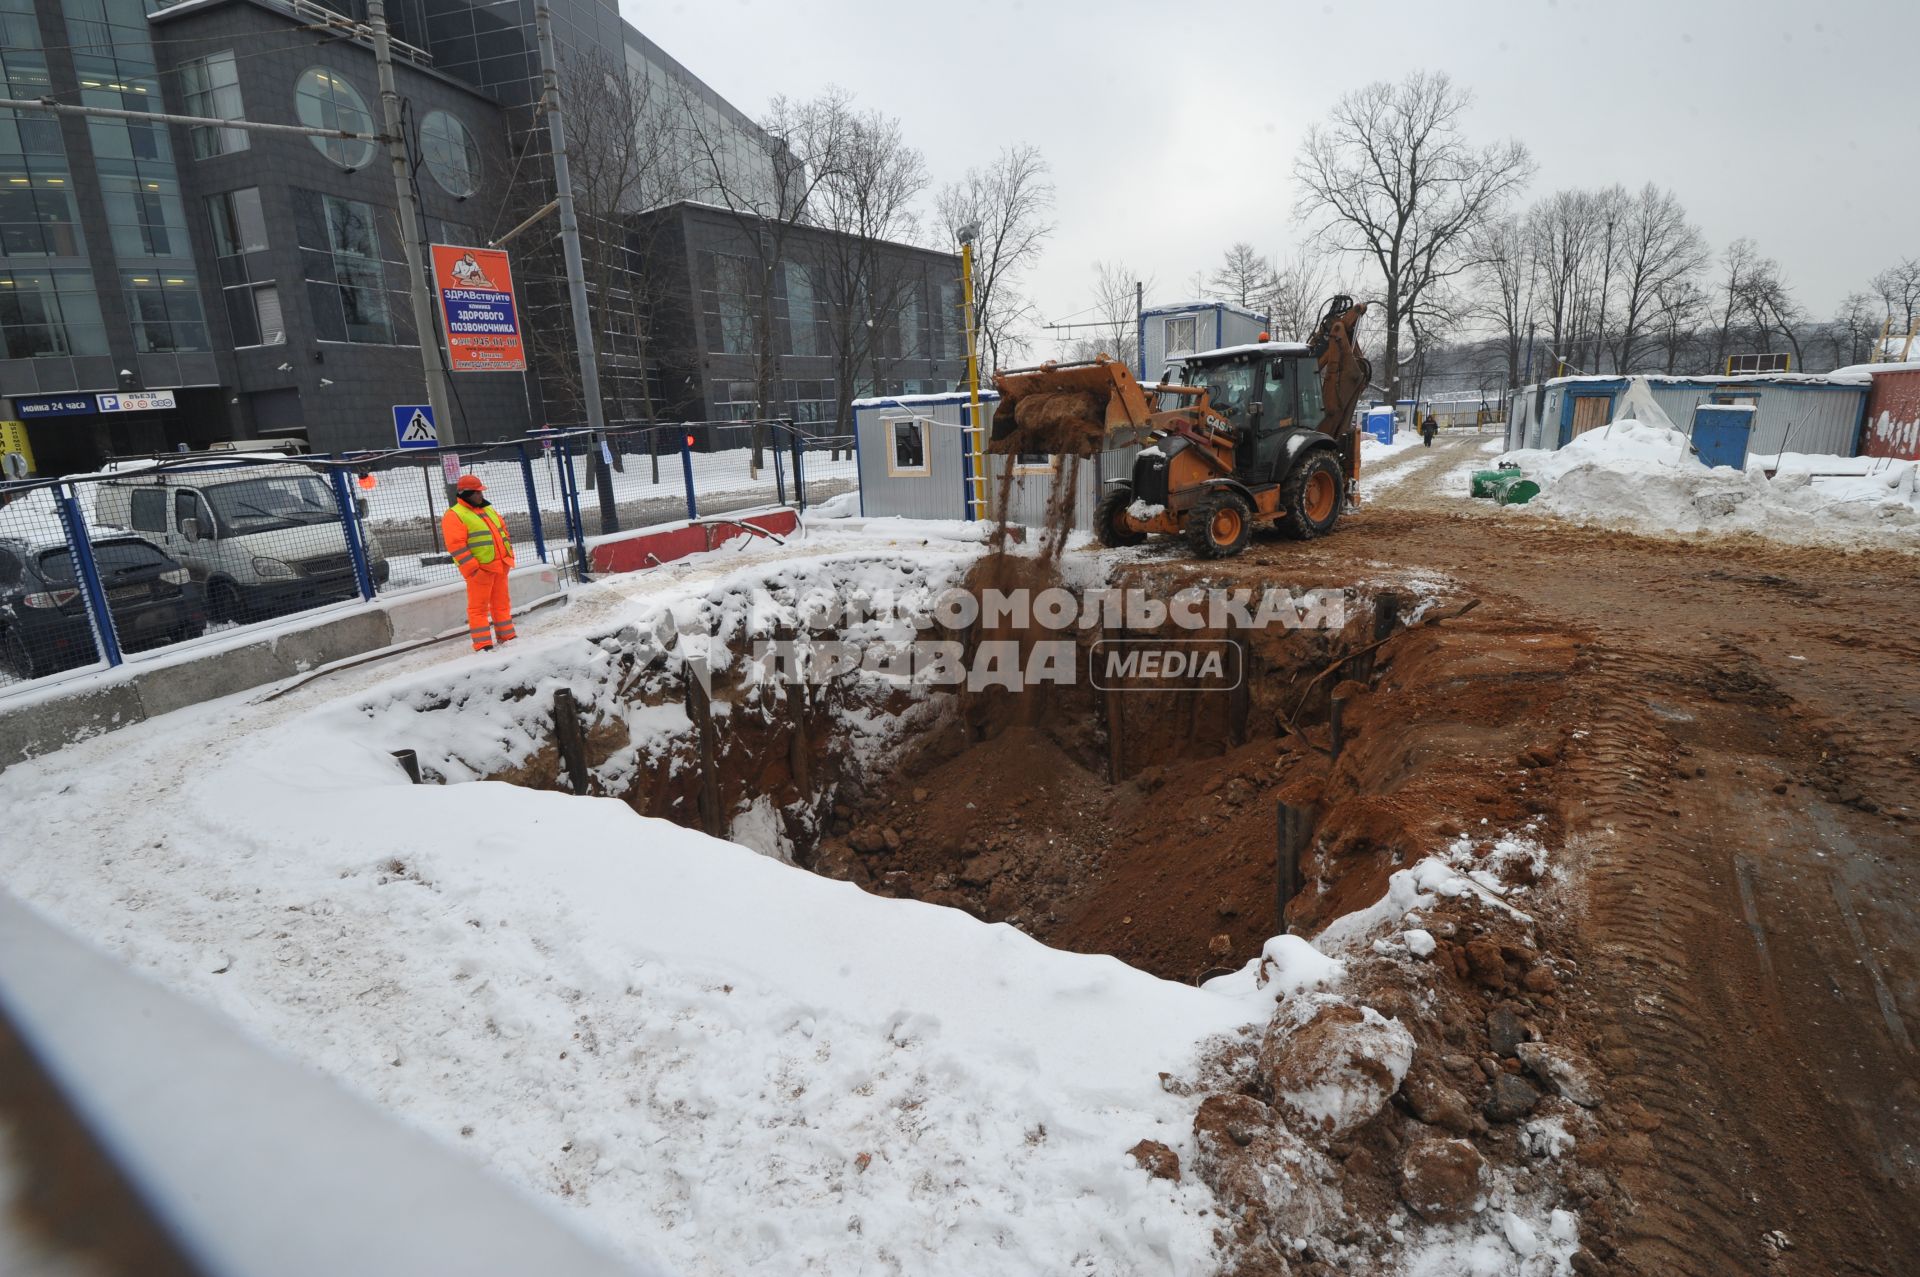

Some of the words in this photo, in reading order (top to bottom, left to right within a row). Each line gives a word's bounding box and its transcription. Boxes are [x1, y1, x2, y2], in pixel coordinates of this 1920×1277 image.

[444, 289, 511, 302] ЗДРАВствуйте
[458, 310, 504, 321] ЗДОРОВОГО
[451, 322, 515, 333] ПОЗВОНОЧНИКА
[22, 404, 50, 412] мойка
[51, 402, 64, 411] 24
[65, 401, 87, 409] часа
